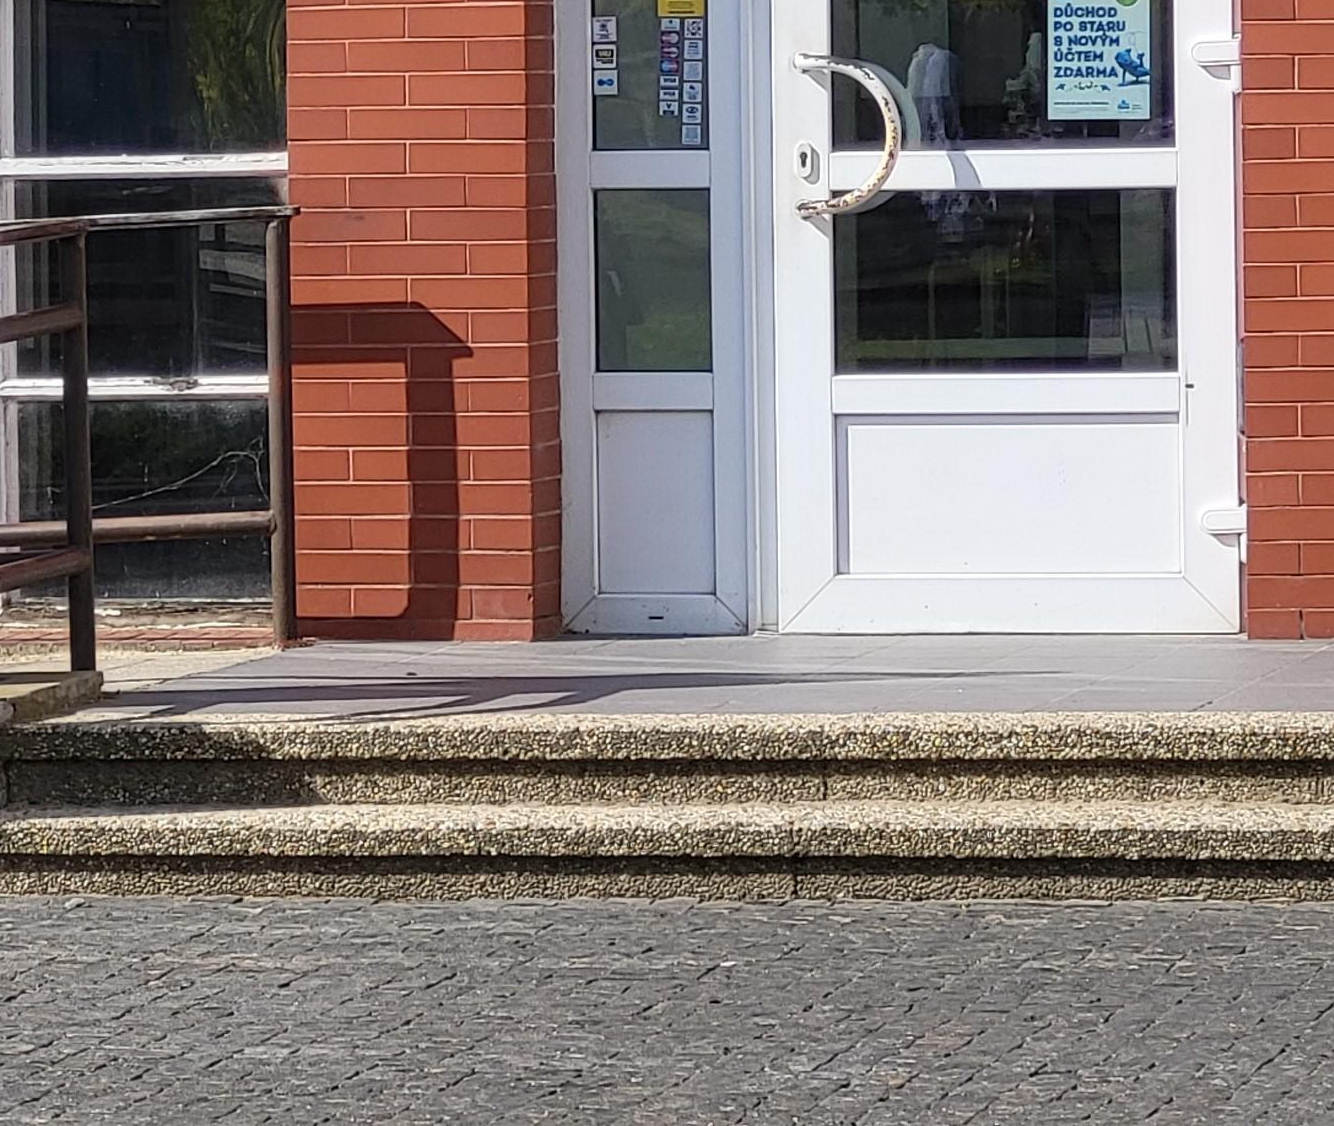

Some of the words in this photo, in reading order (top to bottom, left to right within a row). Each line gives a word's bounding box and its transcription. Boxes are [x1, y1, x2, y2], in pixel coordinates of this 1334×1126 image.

[1053, 3, 1118, 18] DŮCHOD
[1053, 21, 1074, 32] PO
[1053, 35, 1063, 47] S
[1067, 33, 1121, 47] NOVÝM
[1053, 47, 1104, 62] ÚČTEM
[1053, 66, 1119, 79] ZDARMA
